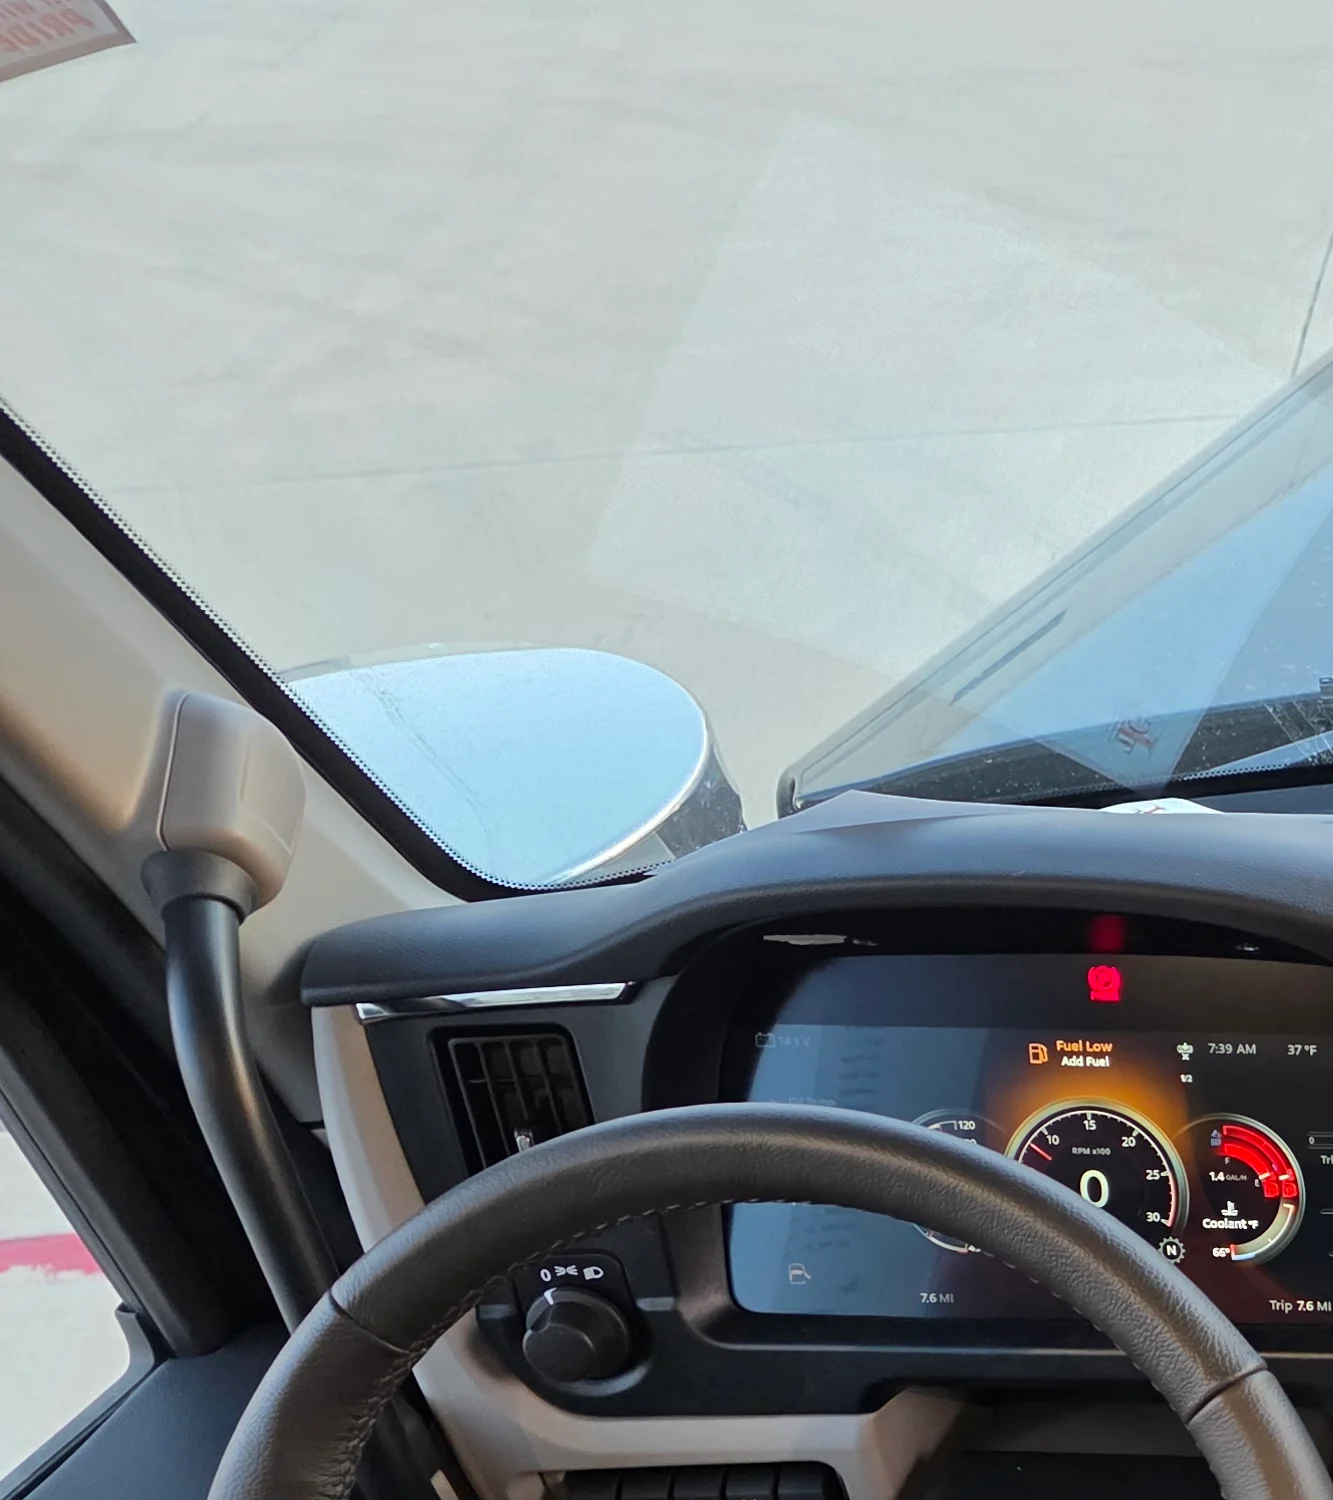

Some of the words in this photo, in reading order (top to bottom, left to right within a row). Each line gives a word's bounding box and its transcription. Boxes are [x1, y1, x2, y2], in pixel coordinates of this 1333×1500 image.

[1056, 1040, 1083, 1052] Fuel
[1086, 1041, 1113, 1052] Low
[1208, 1043, 1233, 1055] 7:39
[1236, 1044, 1257, 1055] AM
[1287, 1045, 1303, 1056] 37
[1061, 1056, 1083, 1067] Add
[1086, 1056, 1110, 1068] Fuel
[958, 1120, 975, 1131] 120
[1083, 1120, 1097, 1131] 15
[1046, 1135, 1060, 1146] 10
[1121, 1136, 1136, 1148] 20
[1072, 1147, 1091, 1155] RPM
[1145, 1170, 1160, 1181] 25
[1209, 1171, 1225, 1182] 1.4
[1080, 1169, 1109, 1208] 0
[1146, 1212, 1160, 1222] 30
[1202, 1218, 1247, 1229] Coolant
[1166, 1245, 1177, 1256] N
[920, 1293, 937, 1304] 7.6
[939, 1294, 954, 1303] MI
[1269, 1300, 1292, 1313] Trip
[1296, 1301, 1314, 1311] 7.6
[1317, 1301, 1331, 1311] MI
